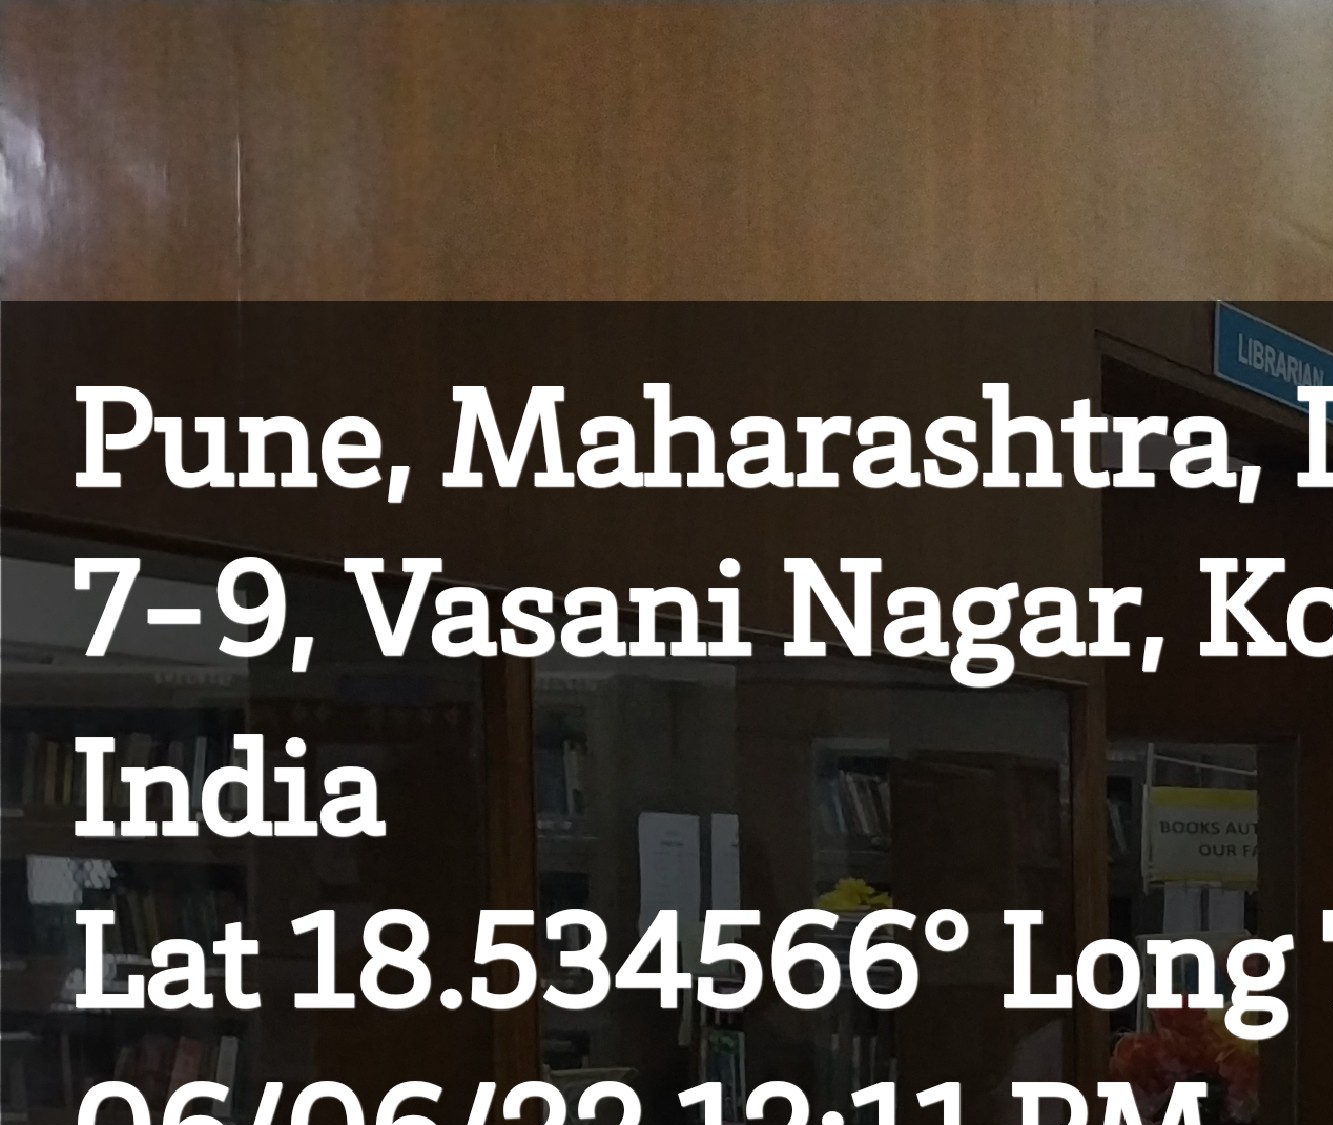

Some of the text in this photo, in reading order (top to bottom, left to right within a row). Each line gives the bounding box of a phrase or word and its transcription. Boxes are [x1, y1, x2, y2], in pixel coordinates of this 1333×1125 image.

[1238, 332, 1325, 387] LIBRARIAN
[1160, 821, 1220, 835] BOOKS
[1198, 844, 1238, 857] OUR
